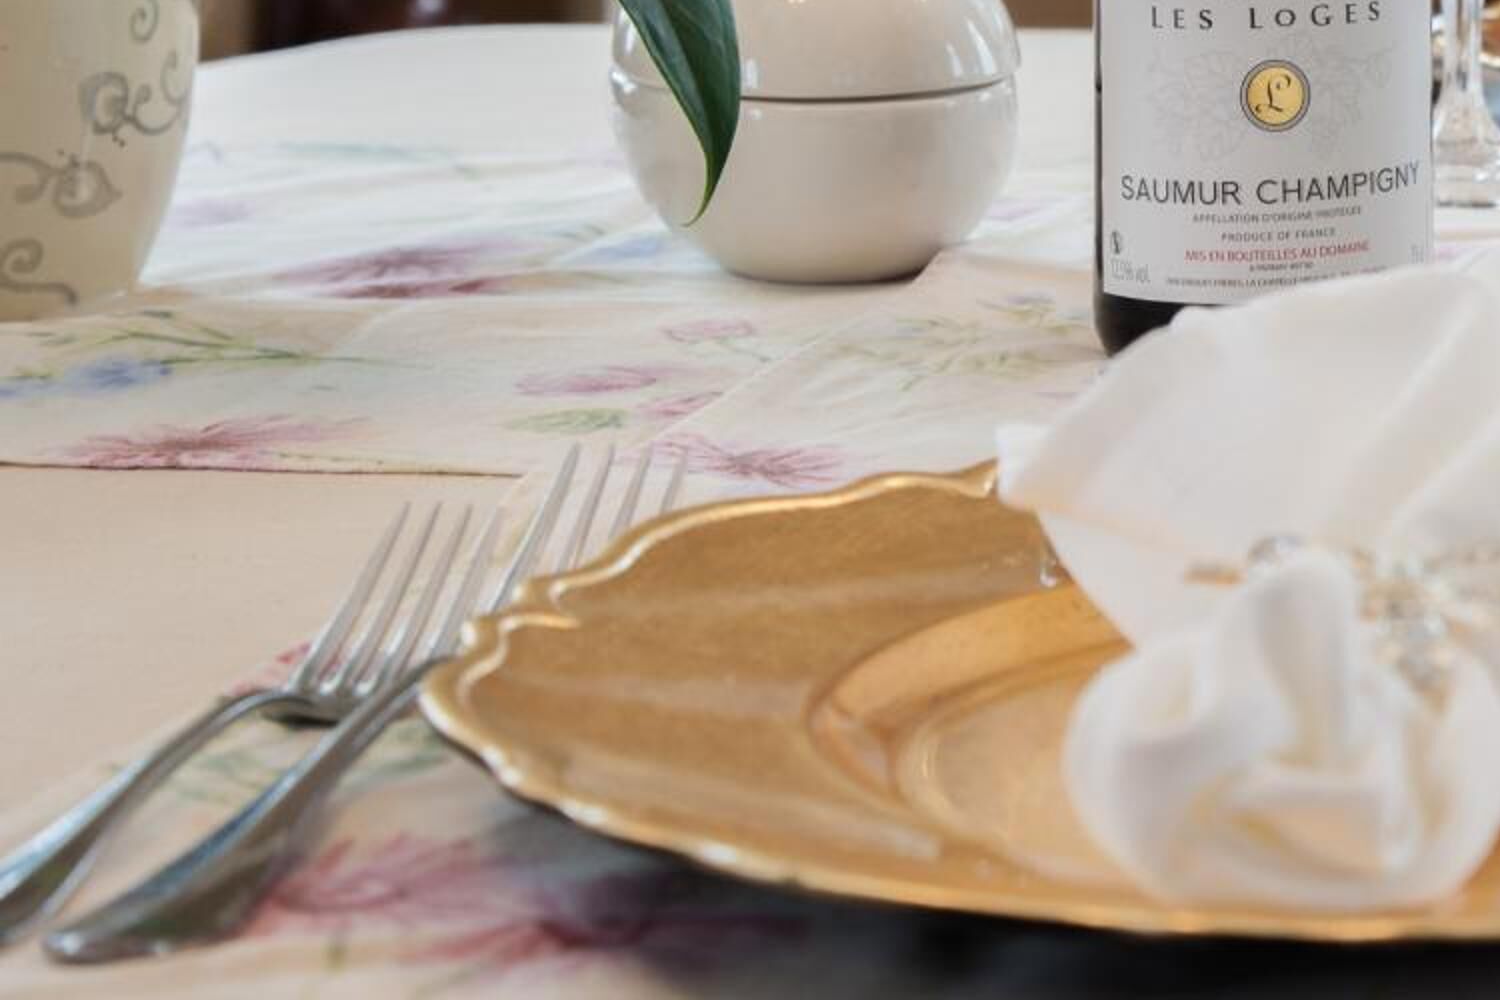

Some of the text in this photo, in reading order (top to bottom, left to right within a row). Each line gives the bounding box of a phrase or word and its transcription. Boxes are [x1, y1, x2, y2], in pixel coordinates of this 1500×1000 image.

[1150, 0, 1381, 30] LES LOGES
[1120, 160, 1419, 206] SAUMUR CHAMPIGNY
[1192, 212, 1259, 225] APPELLATION
[1221, 226, 1336, 243] PRODUCE OF FRANCE
[1184, 240, 1369, 262] MIS EN BOUTEILLES AU DOMAINE
